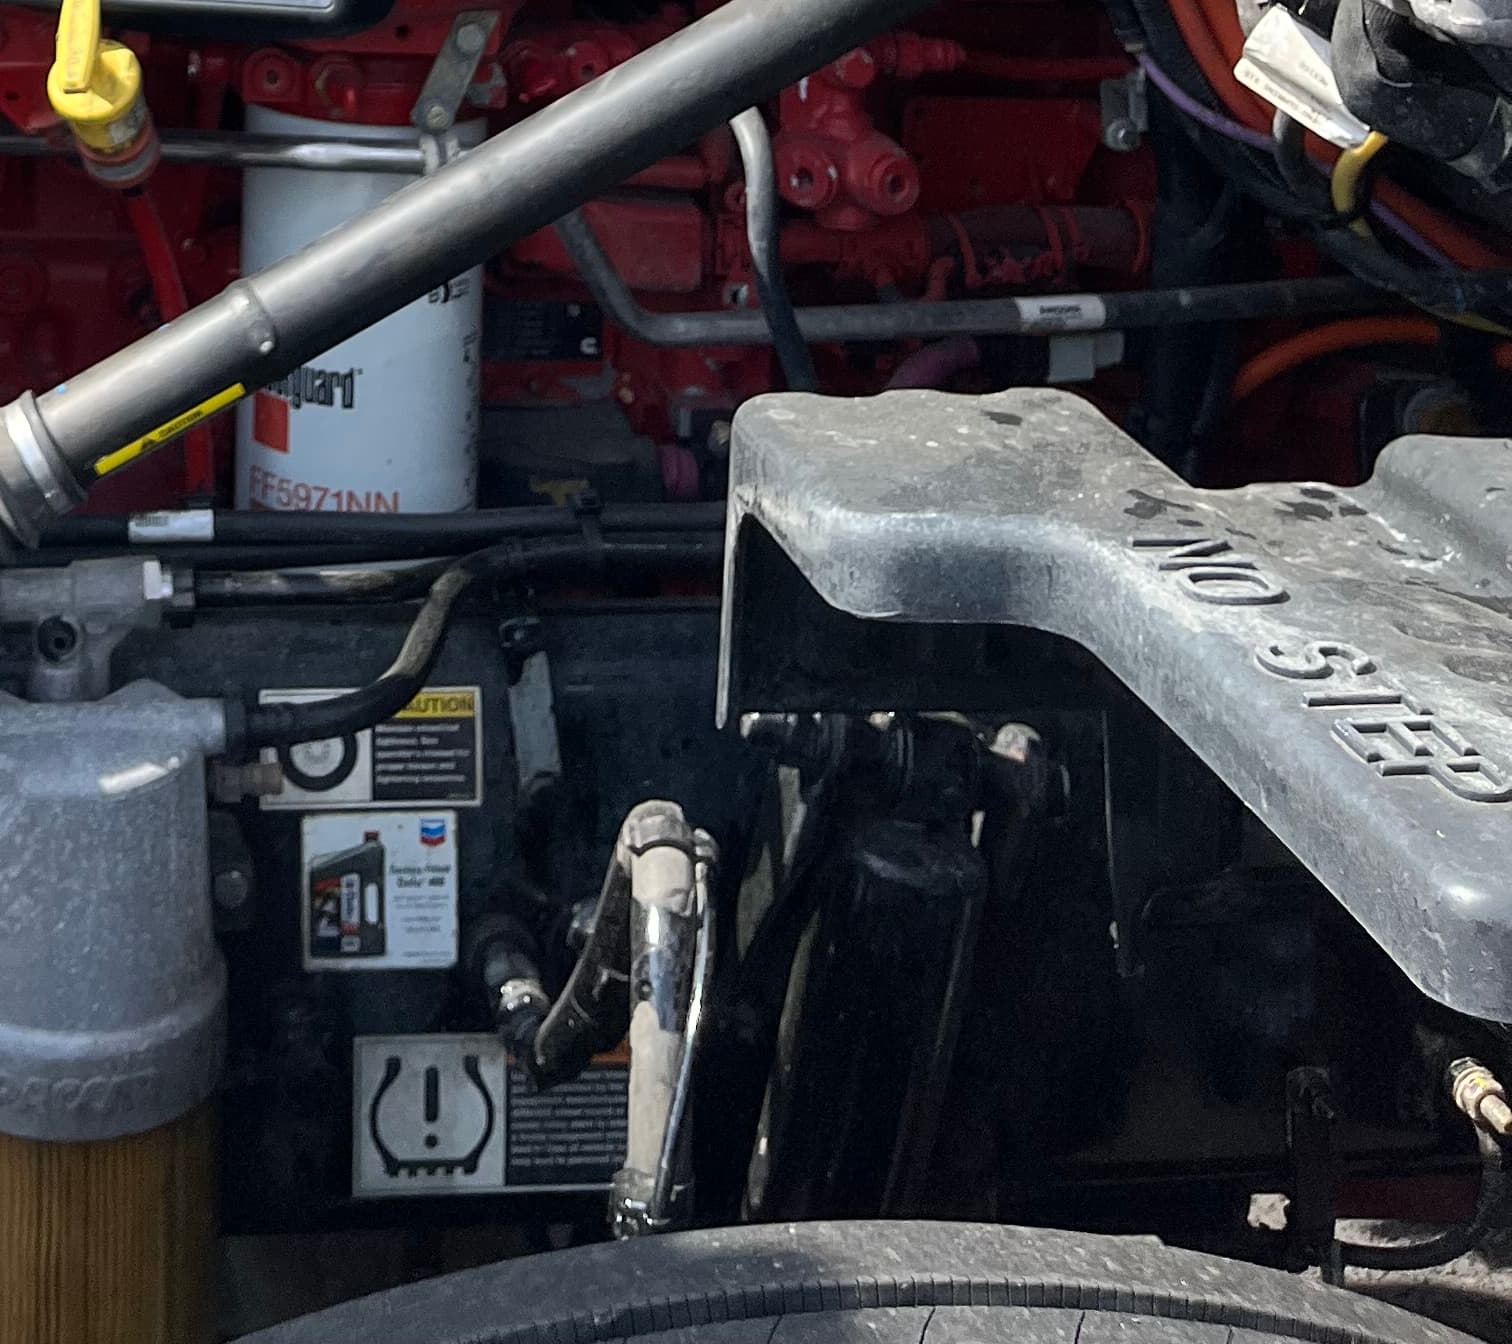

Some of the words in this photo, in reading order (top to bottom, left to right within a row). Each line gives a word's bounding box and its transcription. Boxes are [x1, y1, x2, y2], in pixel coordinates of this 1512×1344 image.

[249, 464, 400, 513] FF5971NN
[1131, 537, 1291, 606] NO
[1255, 639, 1512, 803] STEP
[405, 696, 473, 713] AUTION
